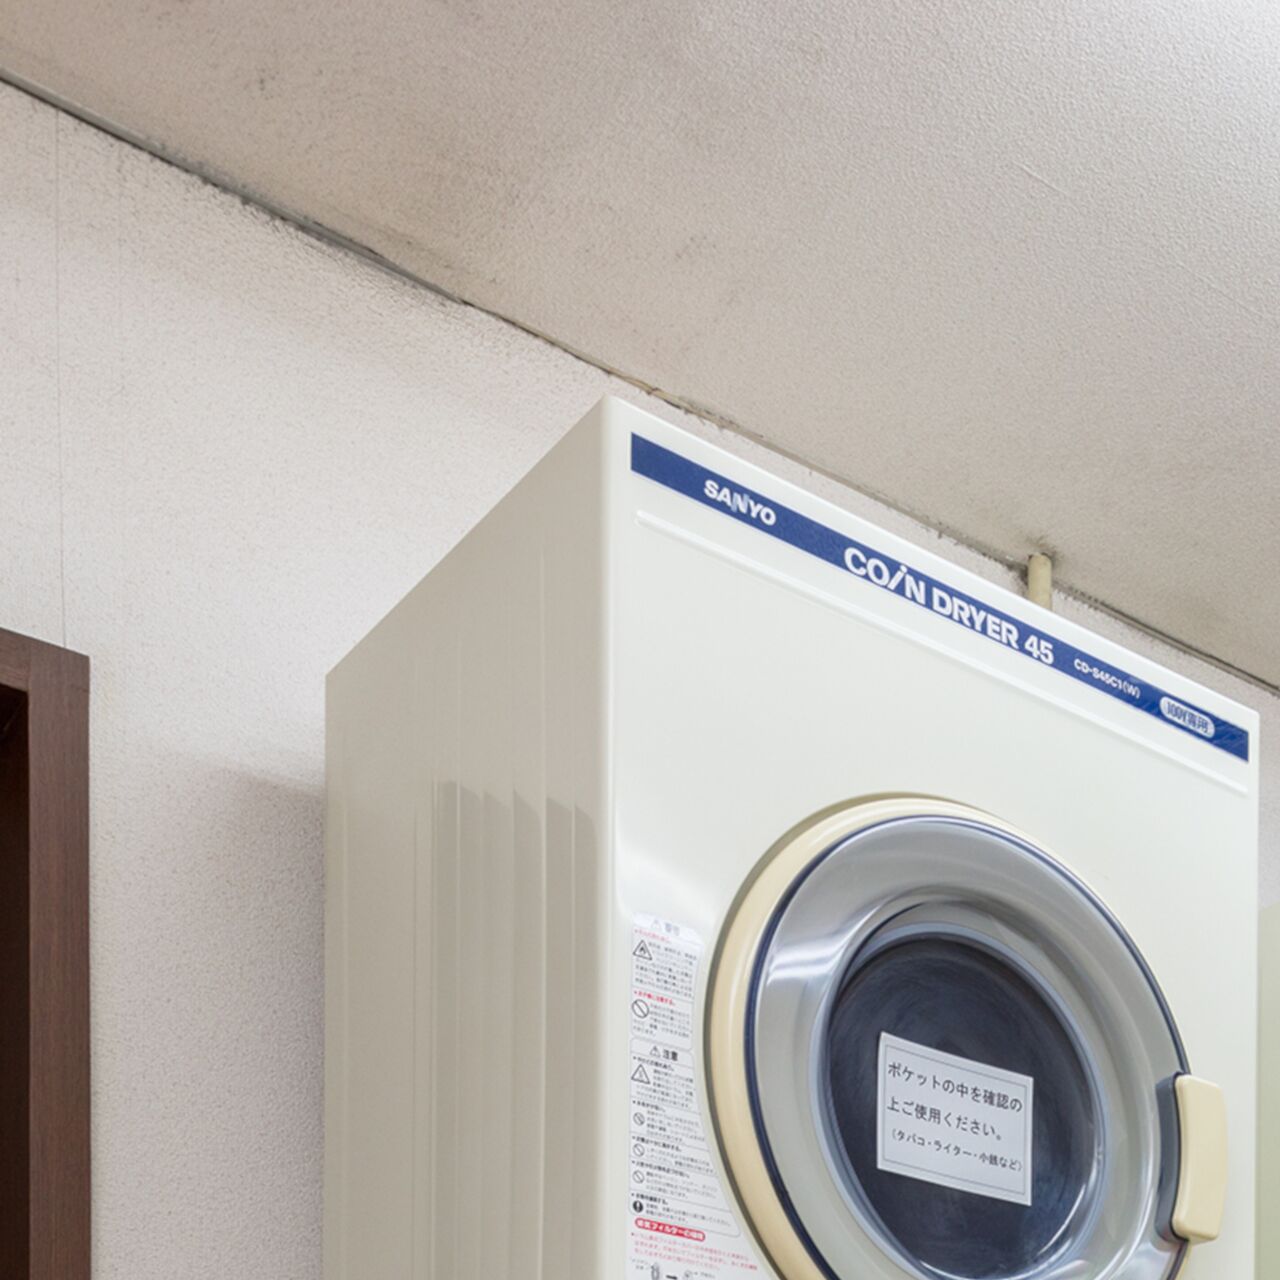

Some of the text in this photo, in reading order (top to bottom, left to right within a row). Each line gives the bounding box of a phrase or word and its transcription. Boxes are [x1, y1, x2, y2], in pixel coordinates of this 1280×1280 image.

[704, 479, 776, 527] SANYO
[932, 586, 1020, 649] DRYER
[1024, 632, 1054, 665] 45
[888, 1061, 1023, 1113] ポケットの中を確認の
[887, 1096, 1003, 1141] 上ご使用ください。
